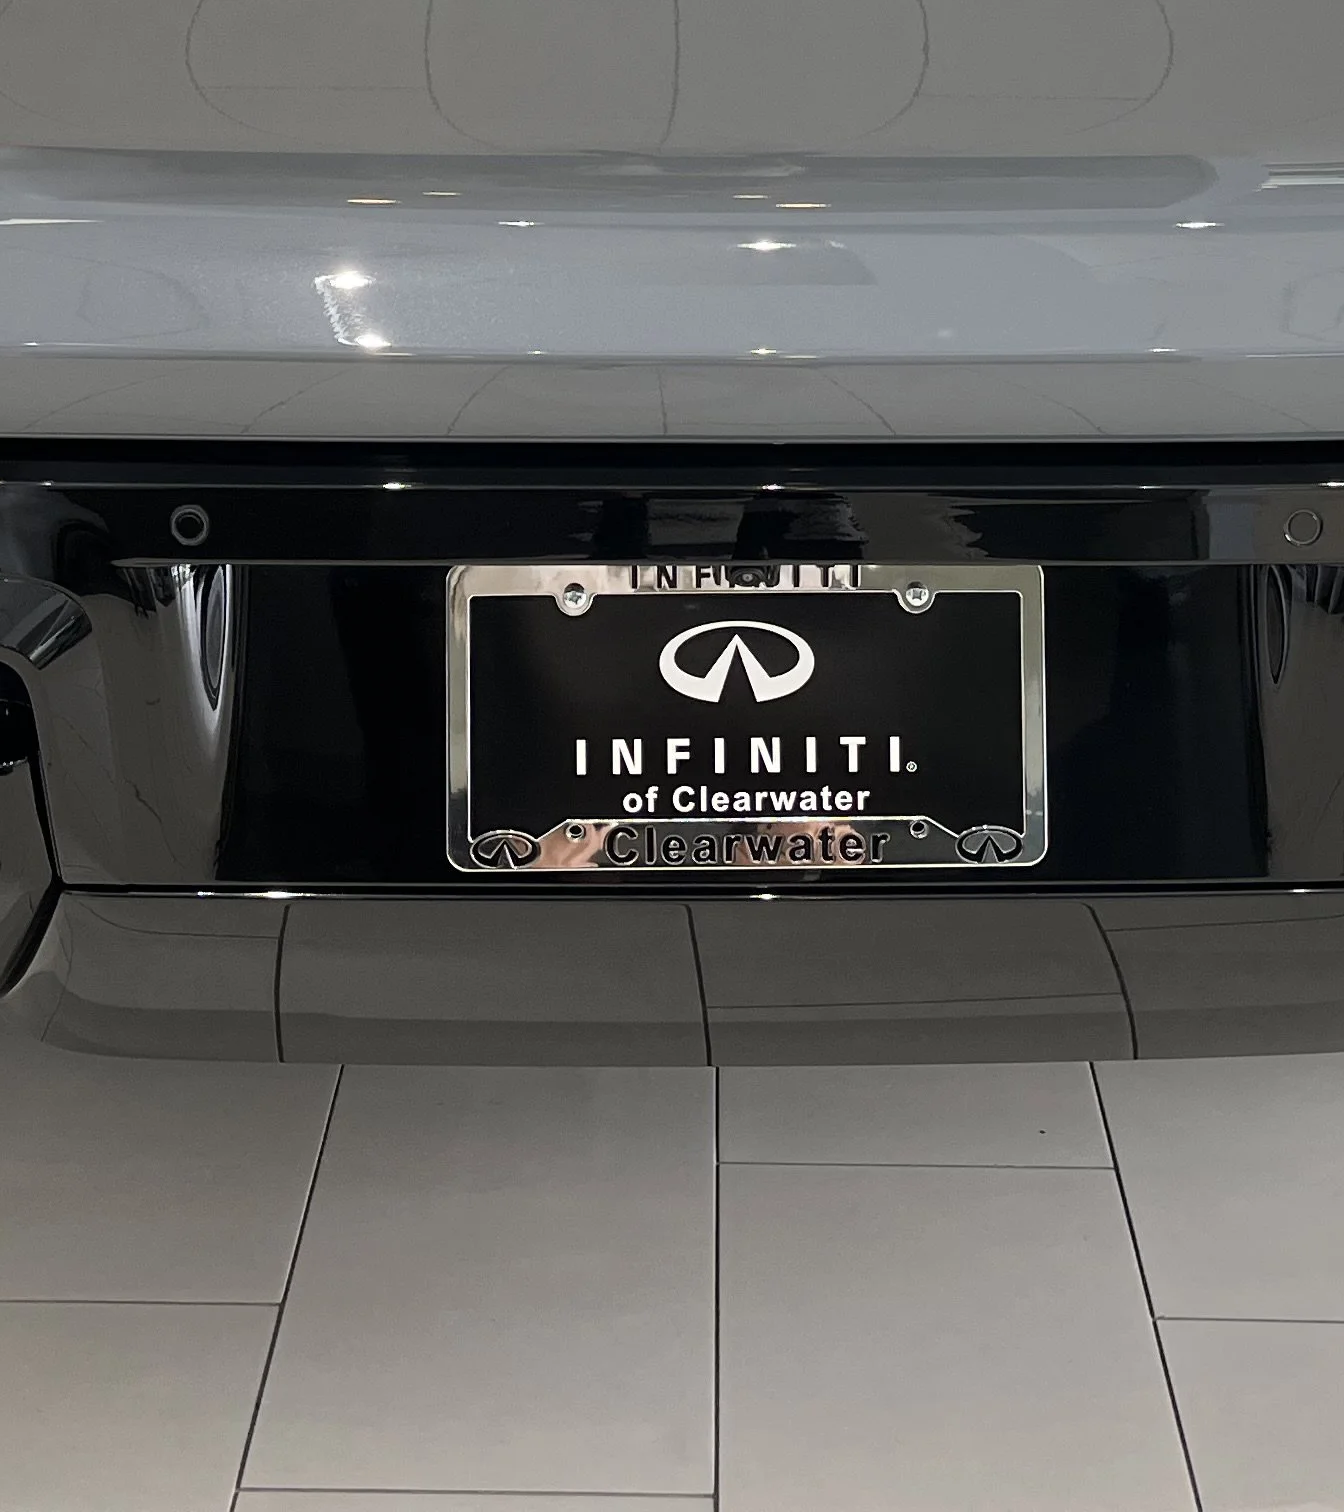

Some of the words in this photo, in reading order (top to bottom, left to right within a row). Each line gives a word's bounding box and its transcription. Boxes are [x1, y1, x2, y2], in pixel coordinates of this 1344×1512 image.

[622, 785, 659, 813] of
[672, 784, 871, 813] Clearwater
[605, 824, 891, 866] Clearwater
